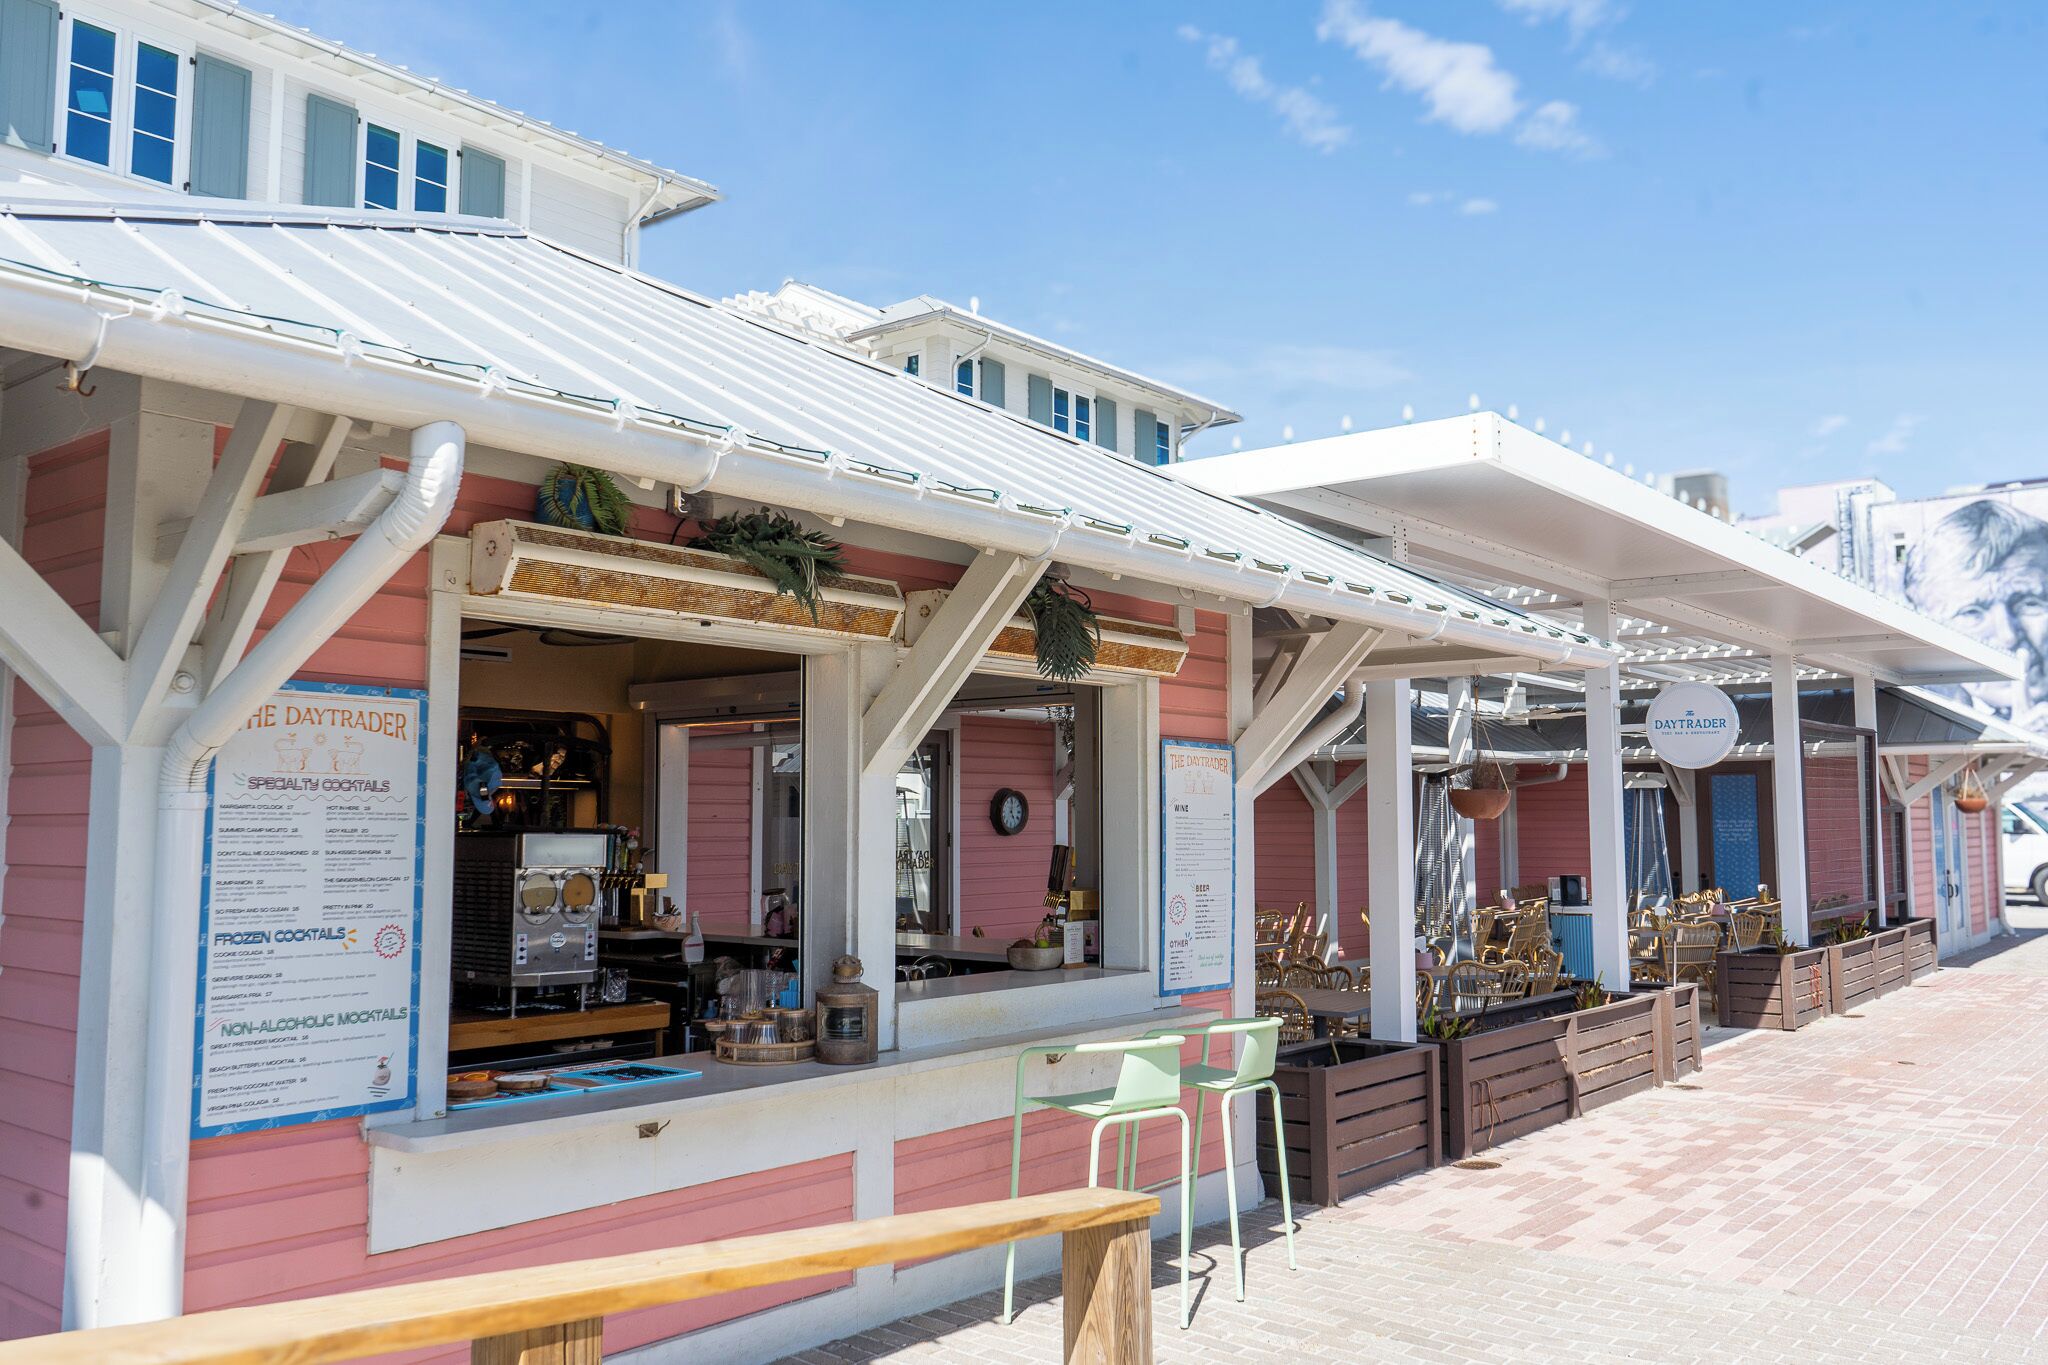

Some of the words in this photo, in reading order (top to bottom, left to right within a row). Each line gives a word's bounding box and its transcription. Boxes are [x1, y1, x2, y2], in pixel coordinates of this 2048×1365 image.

[238, 704, 277, 732] HE
[285, 705, 407, 741] DAYTRADER
[1655, 718, 1726, 730] DAYTRADER
[1170, 753, 1185, 770] THE
[1187, 754, 1228, 775] DAYTRADER
[247, 776, 319, 791] SPECIALTY
[322, 778, 390, 793] COCKTAILS
[1174, 804, 1189, 813] WINE
[1195, 884, 1210, 893] BEER
[214, 930, 271, 946] FROZEN
[274, 926, 346, 943] COCKTAILS
[1169, 939, 1189, 949] OTHER
[221, 1013, 335, 1037] NON-ALCOHOLIC
[337, 1006, 408, 1026] MOCKTAILS
[207, 1087, 228, 1095] FRESH
[274, 1077, 297, 1086] WATER
